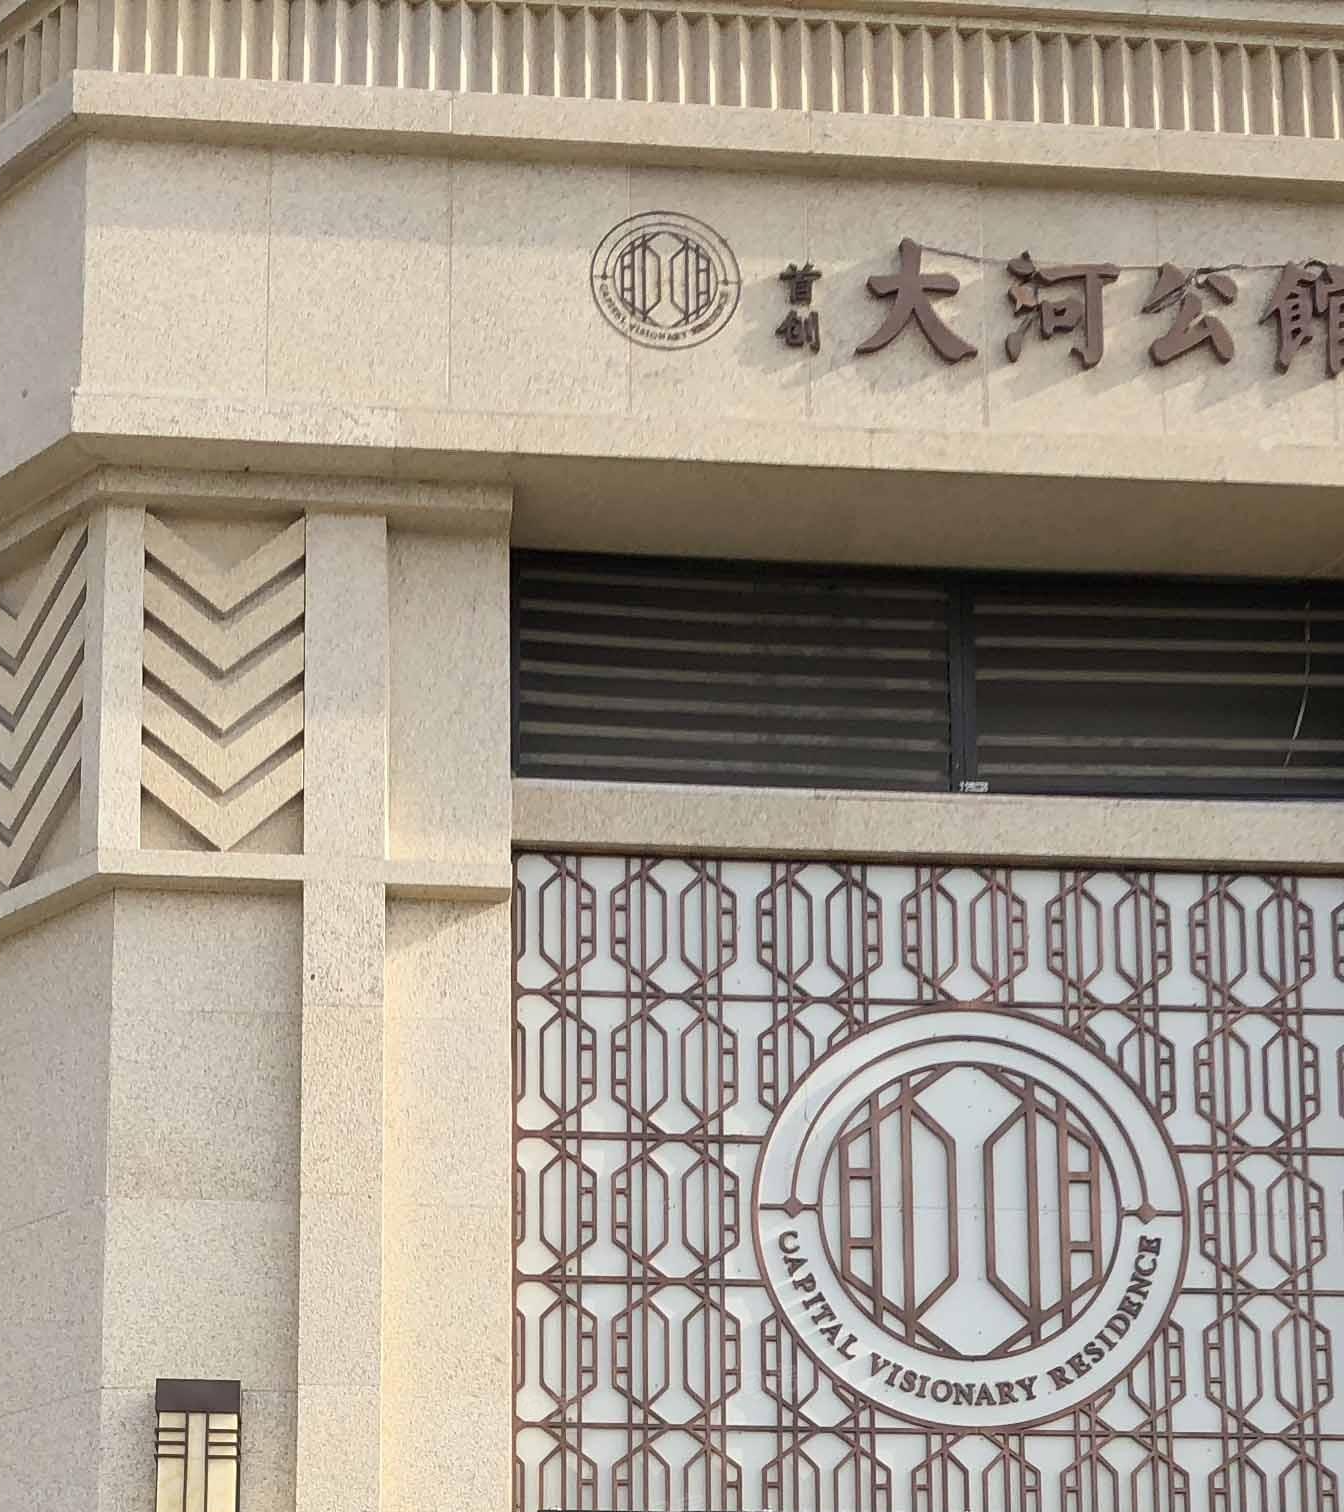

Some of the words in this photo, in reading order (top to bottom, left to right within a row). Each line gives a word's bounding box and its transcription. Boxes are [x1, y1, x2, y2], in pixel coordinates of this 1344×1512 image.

[777, 1229, 857, 1361] CAPITAL
[868, 1351, 1039, 1407] VISIONARY
[1048, 1235, 1163, 1392] RESIDENCE
